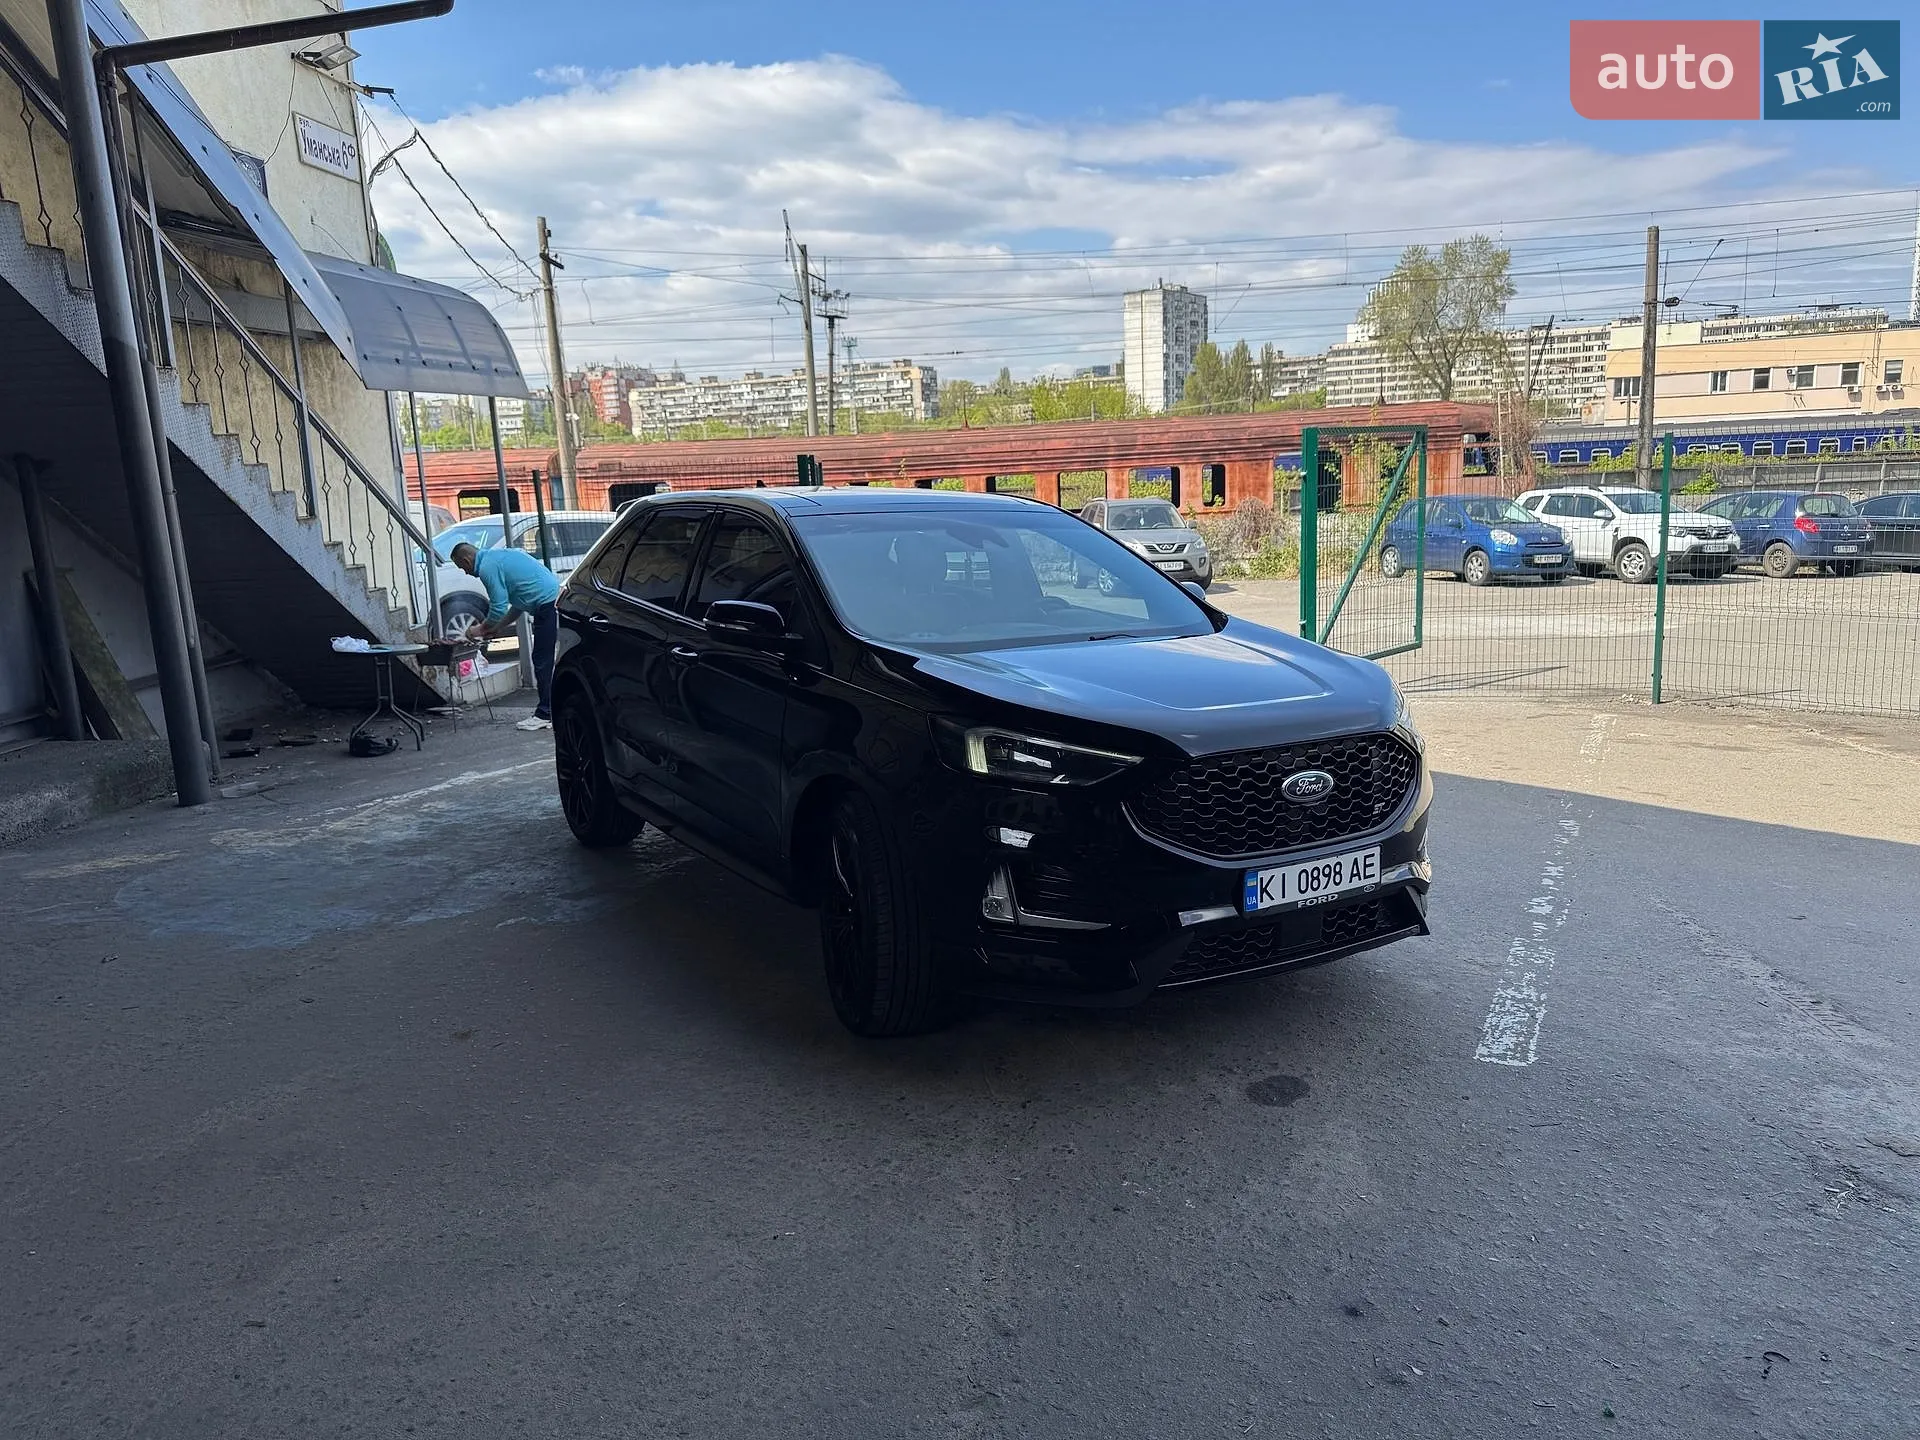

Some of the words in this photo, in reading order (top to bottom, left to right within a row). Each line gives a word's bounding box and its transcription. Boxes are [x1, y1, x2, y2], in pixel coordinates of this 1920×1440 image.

[300, 127, 341, 167] Уманська
[1296, 777, 1324, 795] Ford
[1259, 872, 1286, 903] KI
[1297, 861, 1343, 895] 0898
[1348, 852, 1376, 884] AE
[1246, 896, 1257, 906] UA
[1297, 893, 1338, 909] FORD
